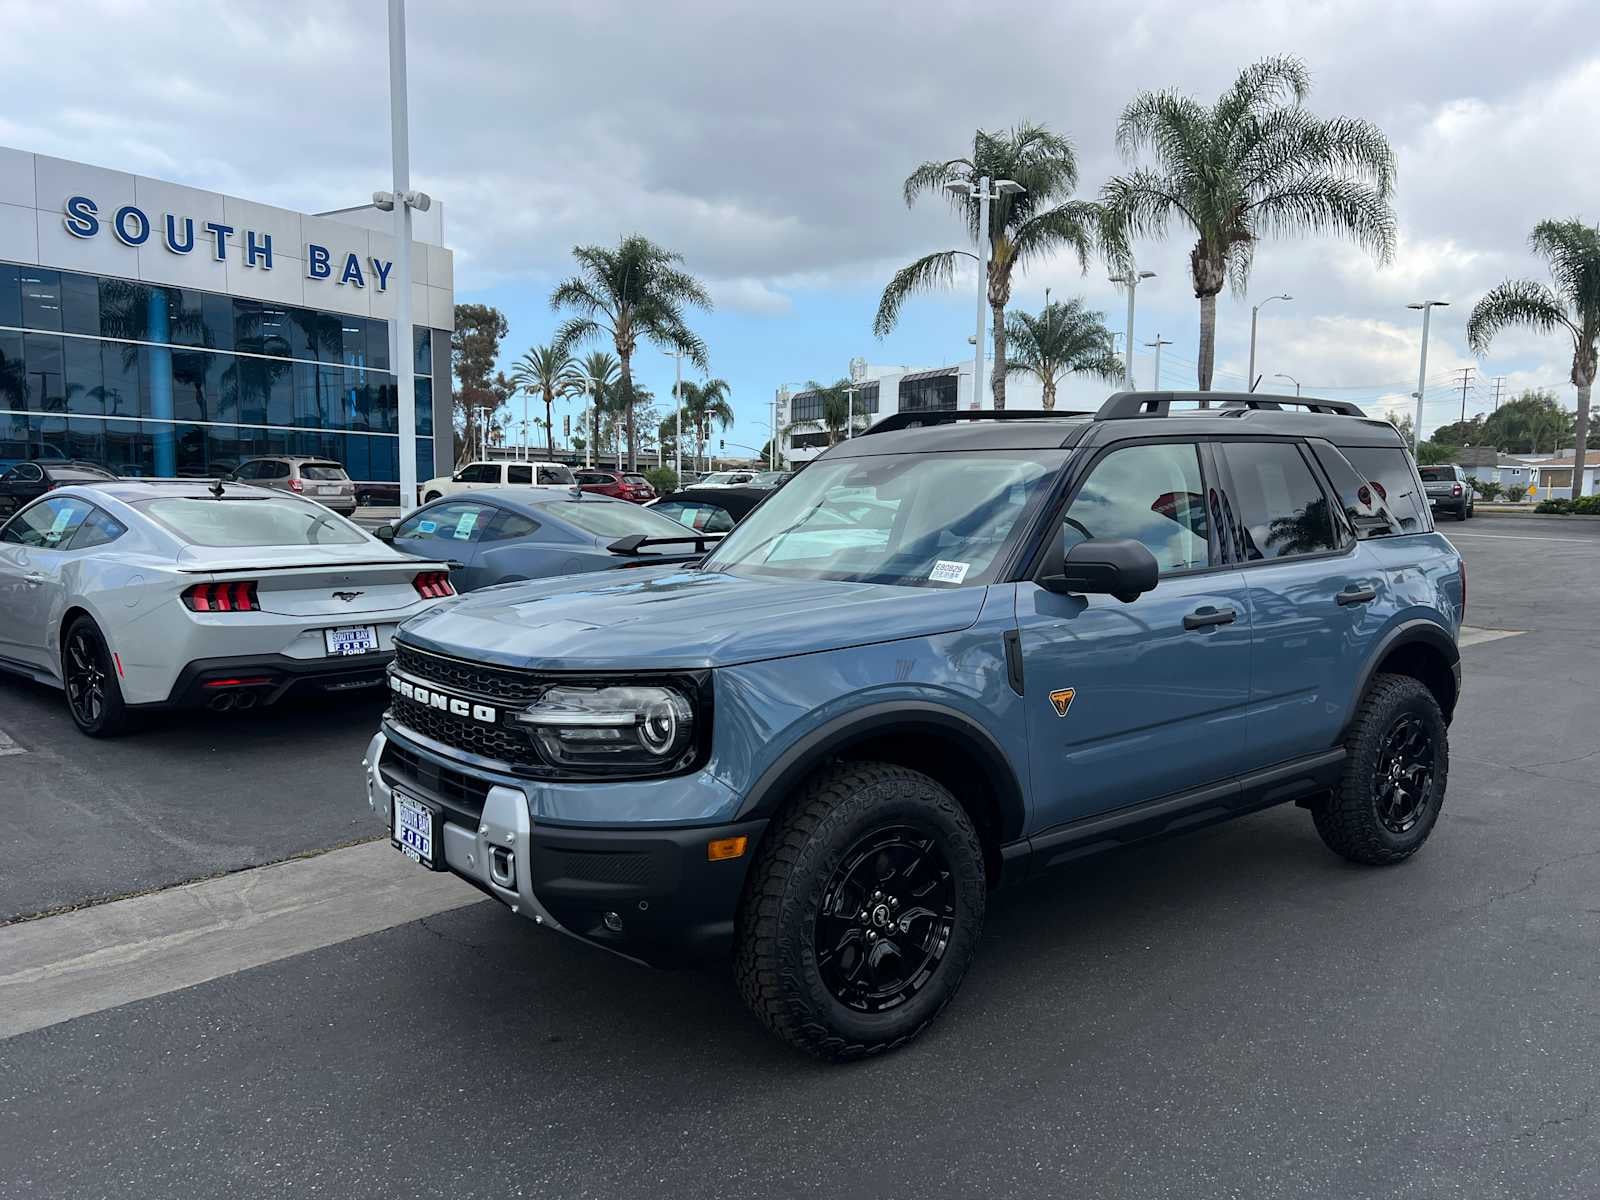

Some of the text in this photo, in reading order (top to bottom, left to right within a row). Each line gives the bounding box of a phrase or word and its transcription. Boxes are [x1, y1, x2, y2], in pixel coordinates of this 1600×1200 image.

[64, 195, 393, 292] SOUTH BAY
[333, 629, 369, 643] SOUTH BAY
[335, 641, 370, 651] FORD
[342, 648, 366, 656] FORD
[390, 676, 496, 723] BRONCO
[400, 805, 429, 835] SOUTH BAY
[401, 827, 429, 853] FORD
[401, 845, 420, 862] FORD
